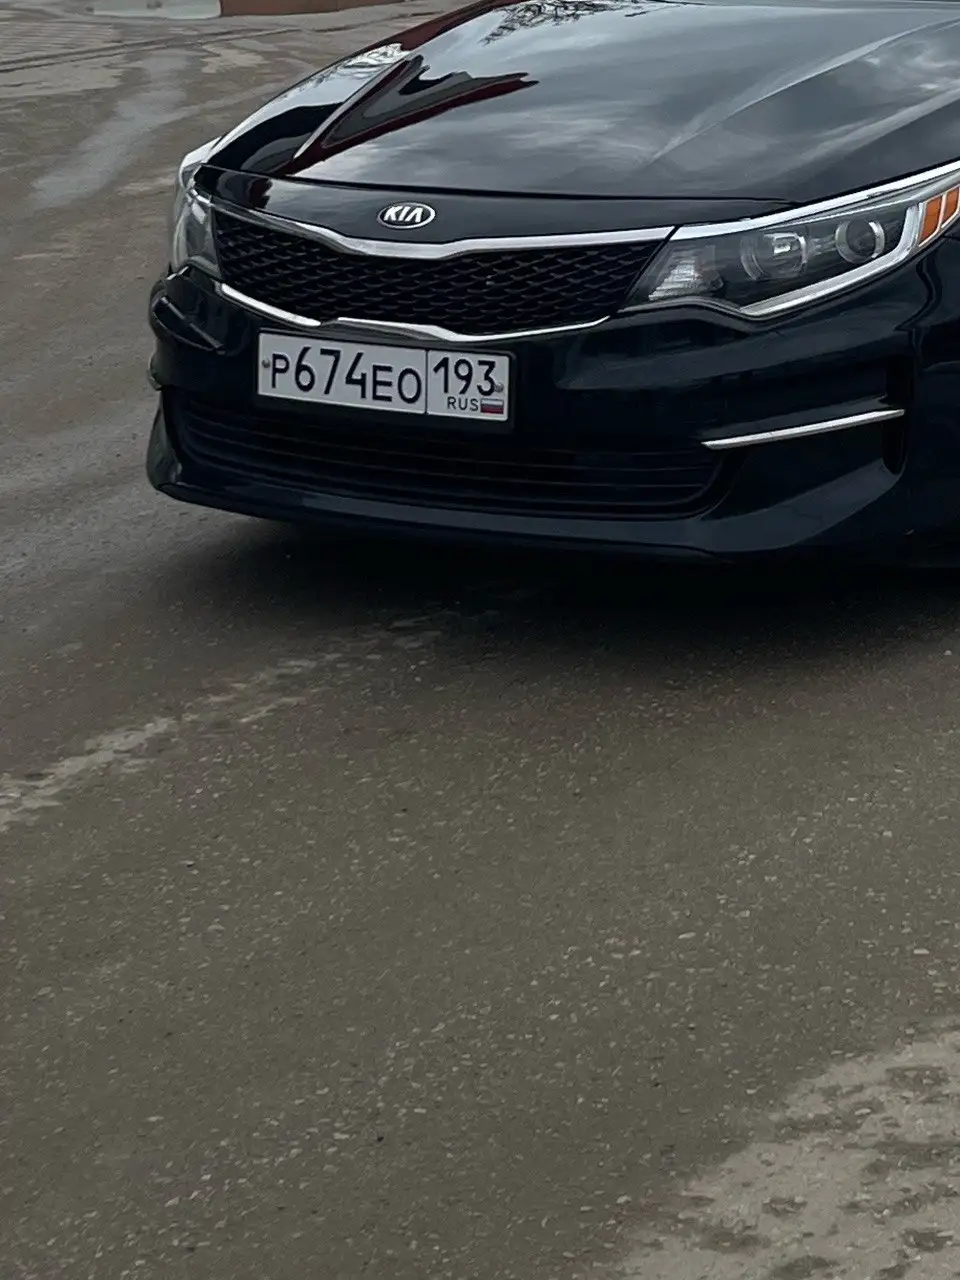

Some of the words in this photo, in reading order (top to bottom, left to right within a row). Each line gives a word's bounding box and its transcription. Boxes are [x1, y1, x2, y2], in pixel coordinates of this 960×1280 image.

[383, 205, 424, 223] KIA
[270, 345, 423, 405] Р674ЕО
[432, 356, 497, 397] 193
[446, 396, 480, 412] RUS
